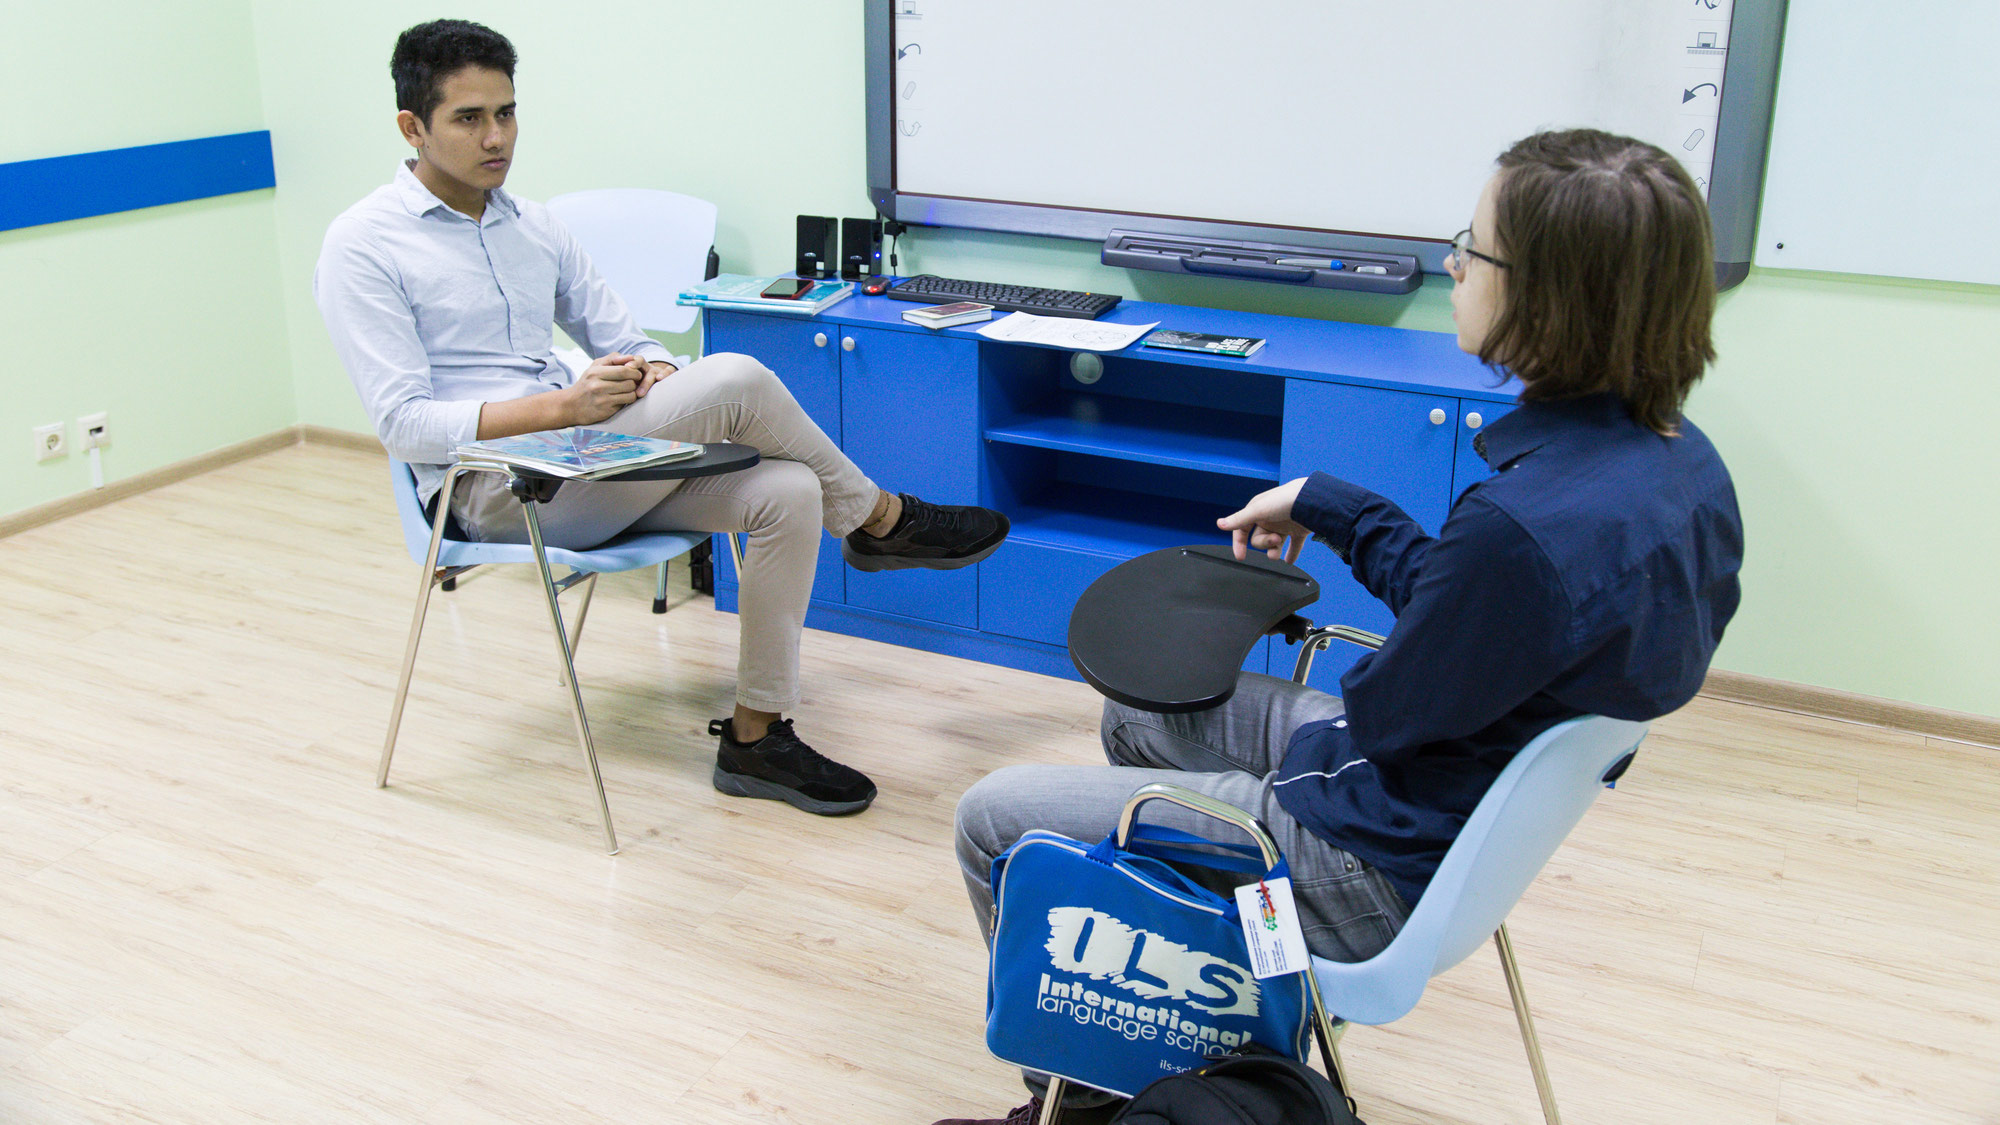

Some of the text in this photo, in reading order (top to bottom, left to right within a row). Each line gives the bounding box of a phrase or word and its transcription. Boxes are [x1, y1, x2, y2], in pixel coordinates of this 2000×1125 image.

[1036, 980, 1239, 1057] language scho
[1039, 972, 1254, 1050] International
